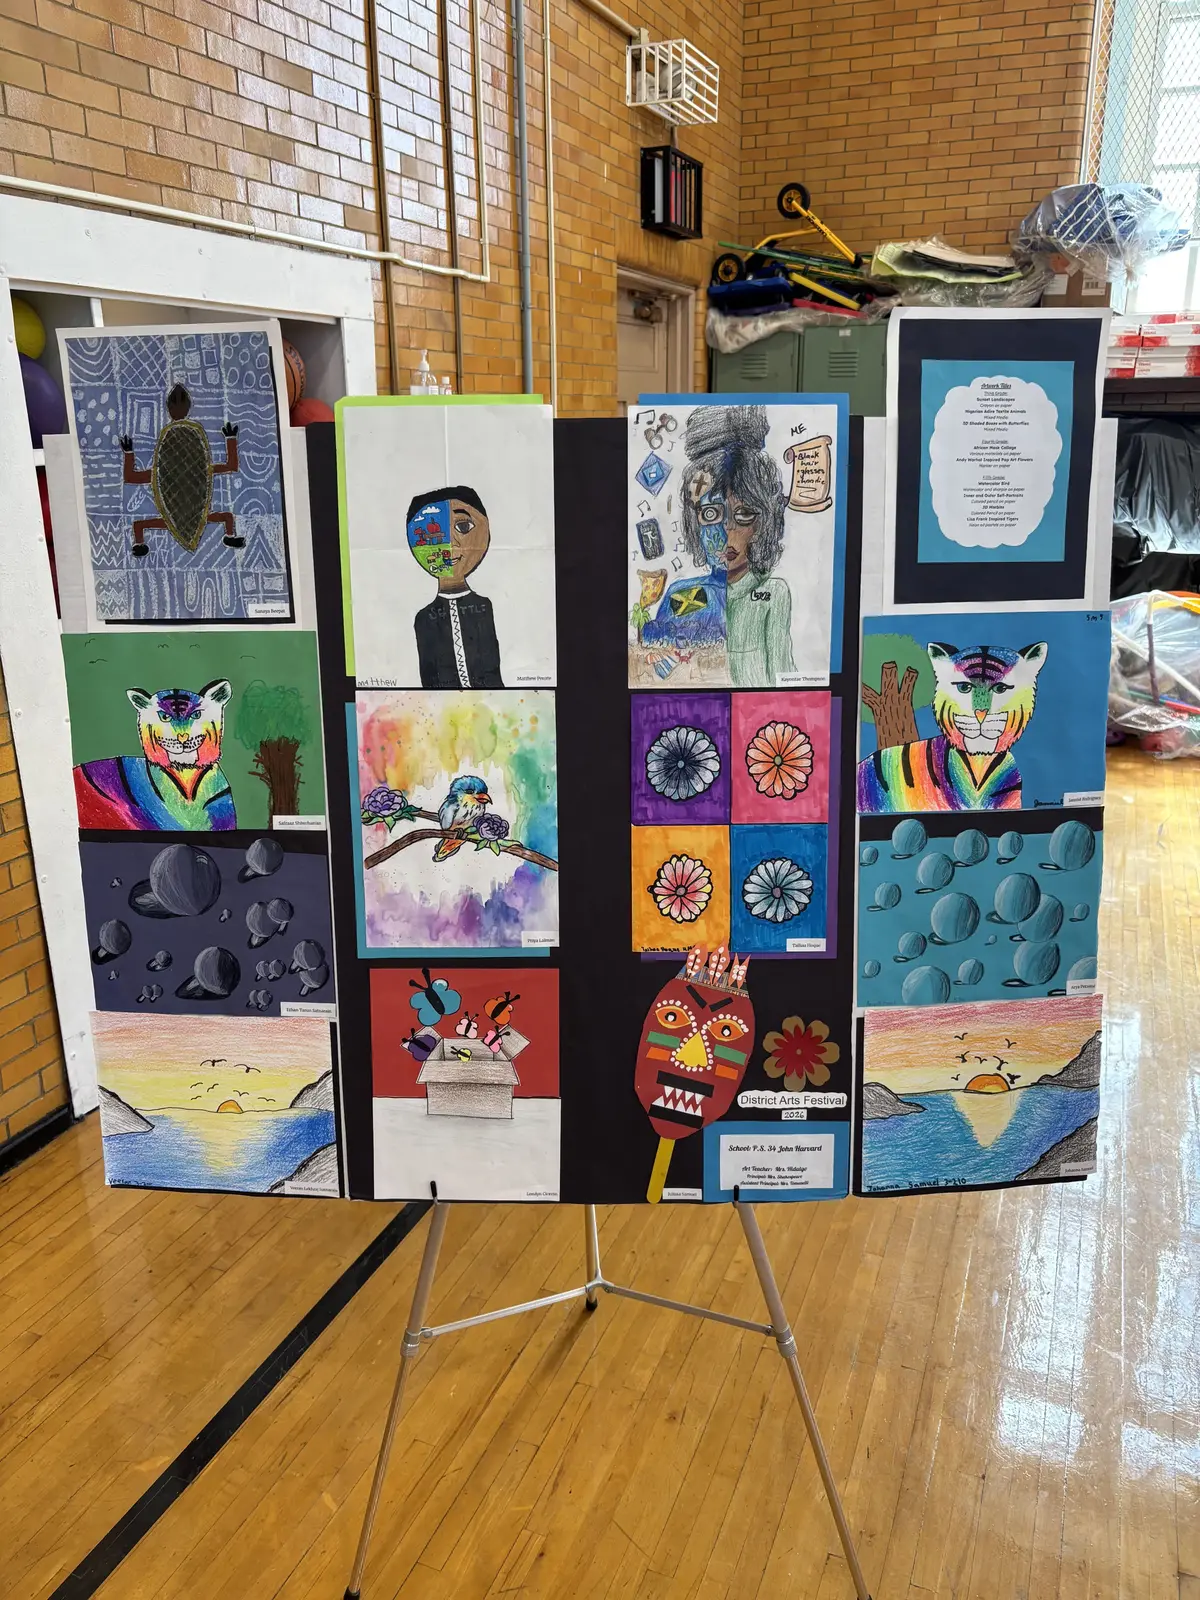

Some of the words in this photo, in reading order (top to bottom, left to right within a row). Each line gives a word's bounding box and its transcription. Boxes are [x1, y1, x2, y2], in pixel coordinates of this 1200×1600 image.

[791, 423, 807, 437] ME
[741, 1095, 777, 1105] District
[779, 1095, 800, 1105] Arts
[804, 1095, 845, 1105] Festival
[784, 1111, 805, 1119] 2026
[777, 1145, 793, 1153] John
[908, 1178, 939, 1188] Samuel
